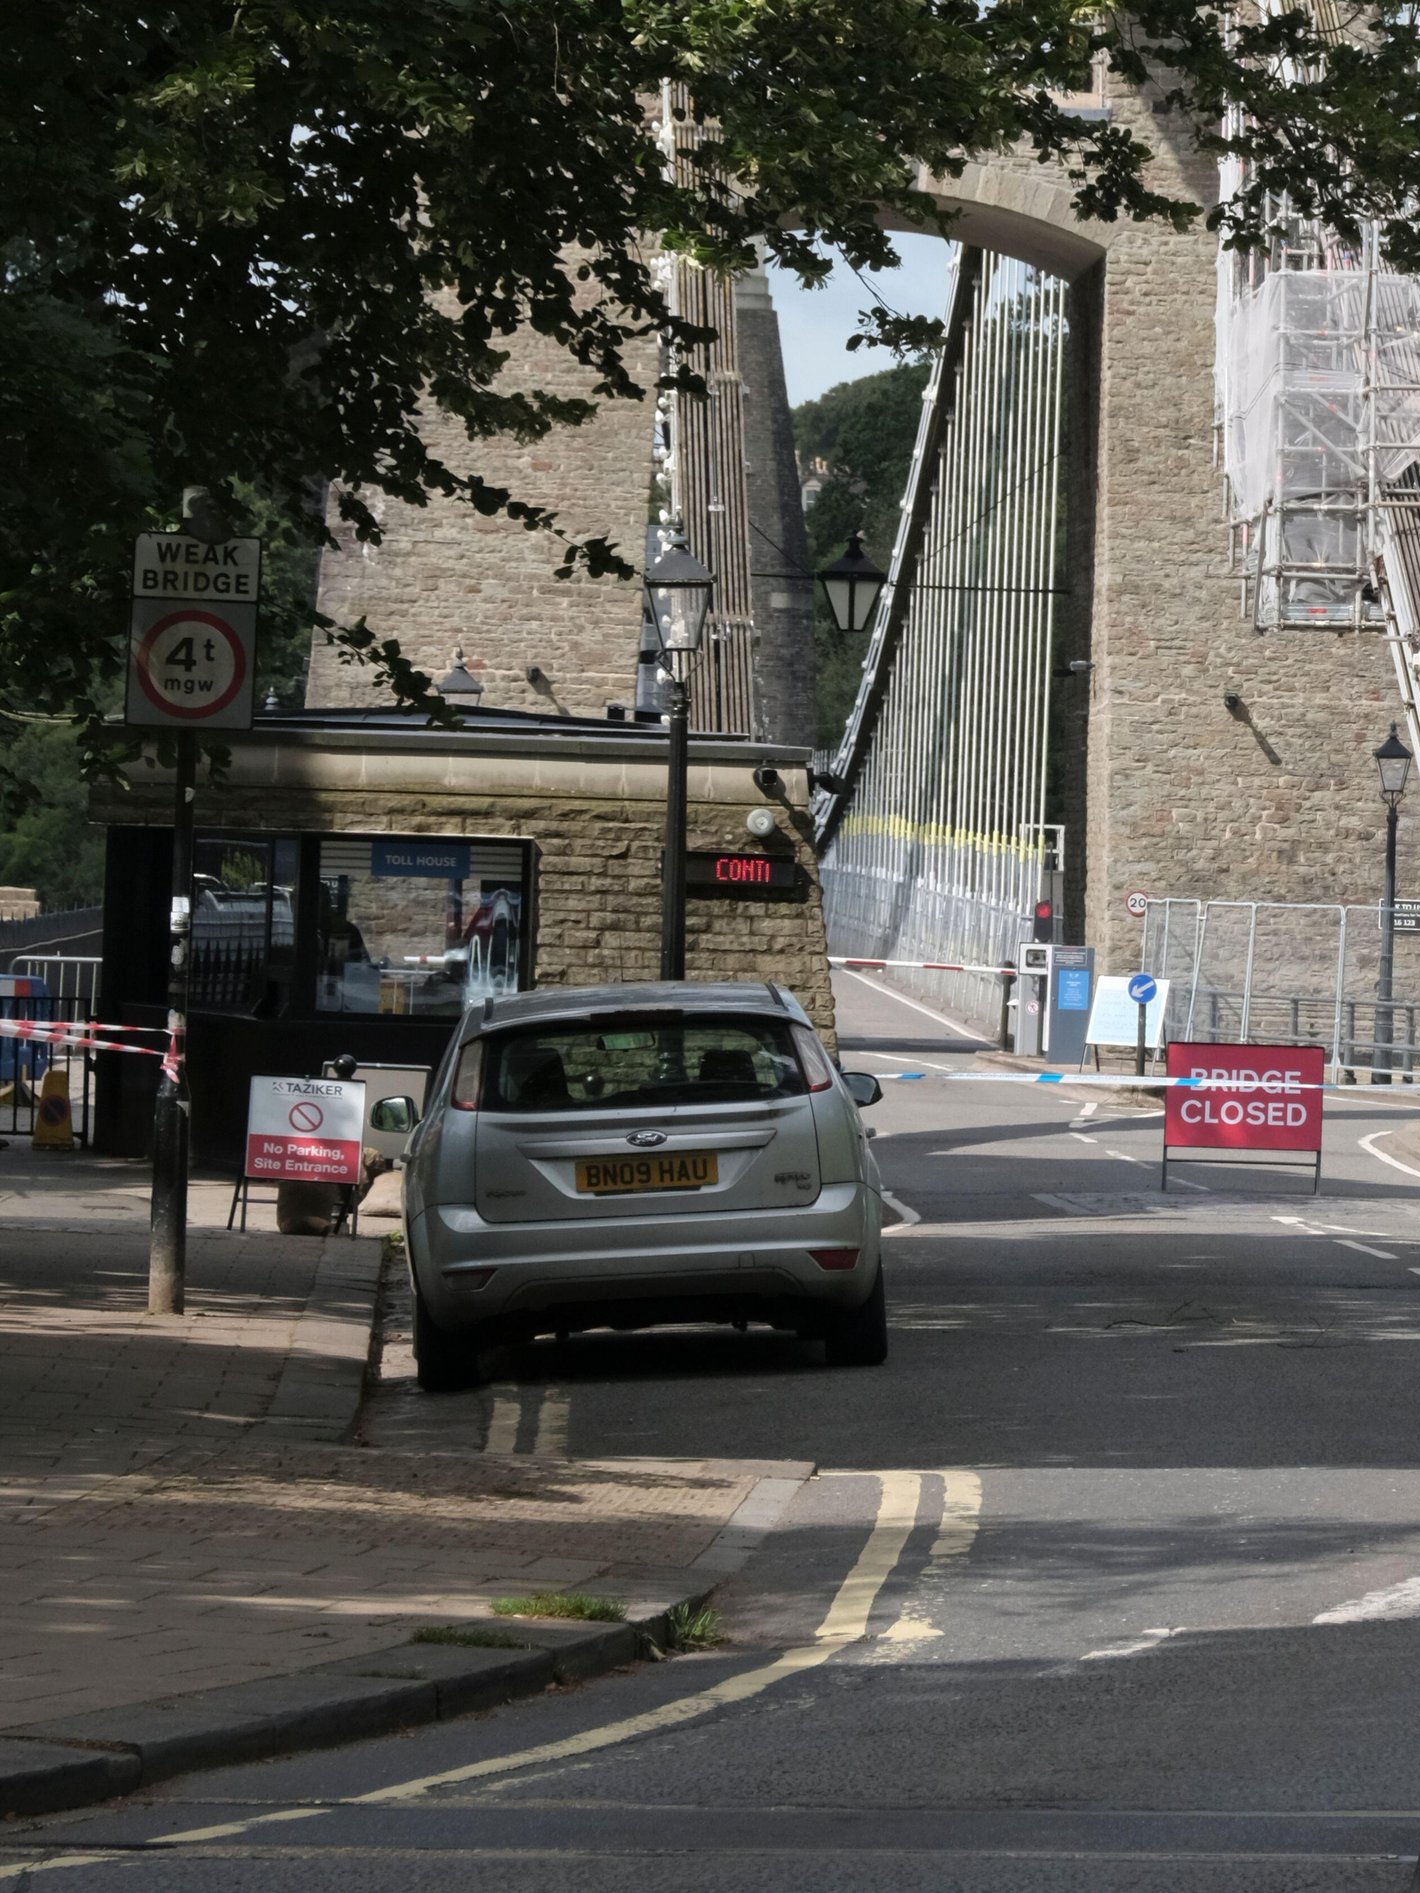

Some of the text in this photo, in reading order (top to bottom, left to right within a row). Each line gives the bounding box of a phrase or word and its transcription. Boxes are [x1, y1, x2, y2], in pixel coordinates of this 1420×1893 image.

[157, 542, 240, 567] WEAK
[142, 569, 249, 595] BRIDGE
[164, 678, 214, 694] mgw
[385, 854, 457, 868] TOLL HOUSE
[1130, 898, 1146, 908] 20
[286, 1082, 343, 1096] TAZIKER
[1190, 1068, 1302, 1095] BRIDGE
[1180, 1099, 1307, 1127] CLOSED
[263, 1142, 344, 1160] No Parking,
[254, 1157, 348, 1174] Site Entrance
[586, 1158, 709, 1188] BN09 HAU
